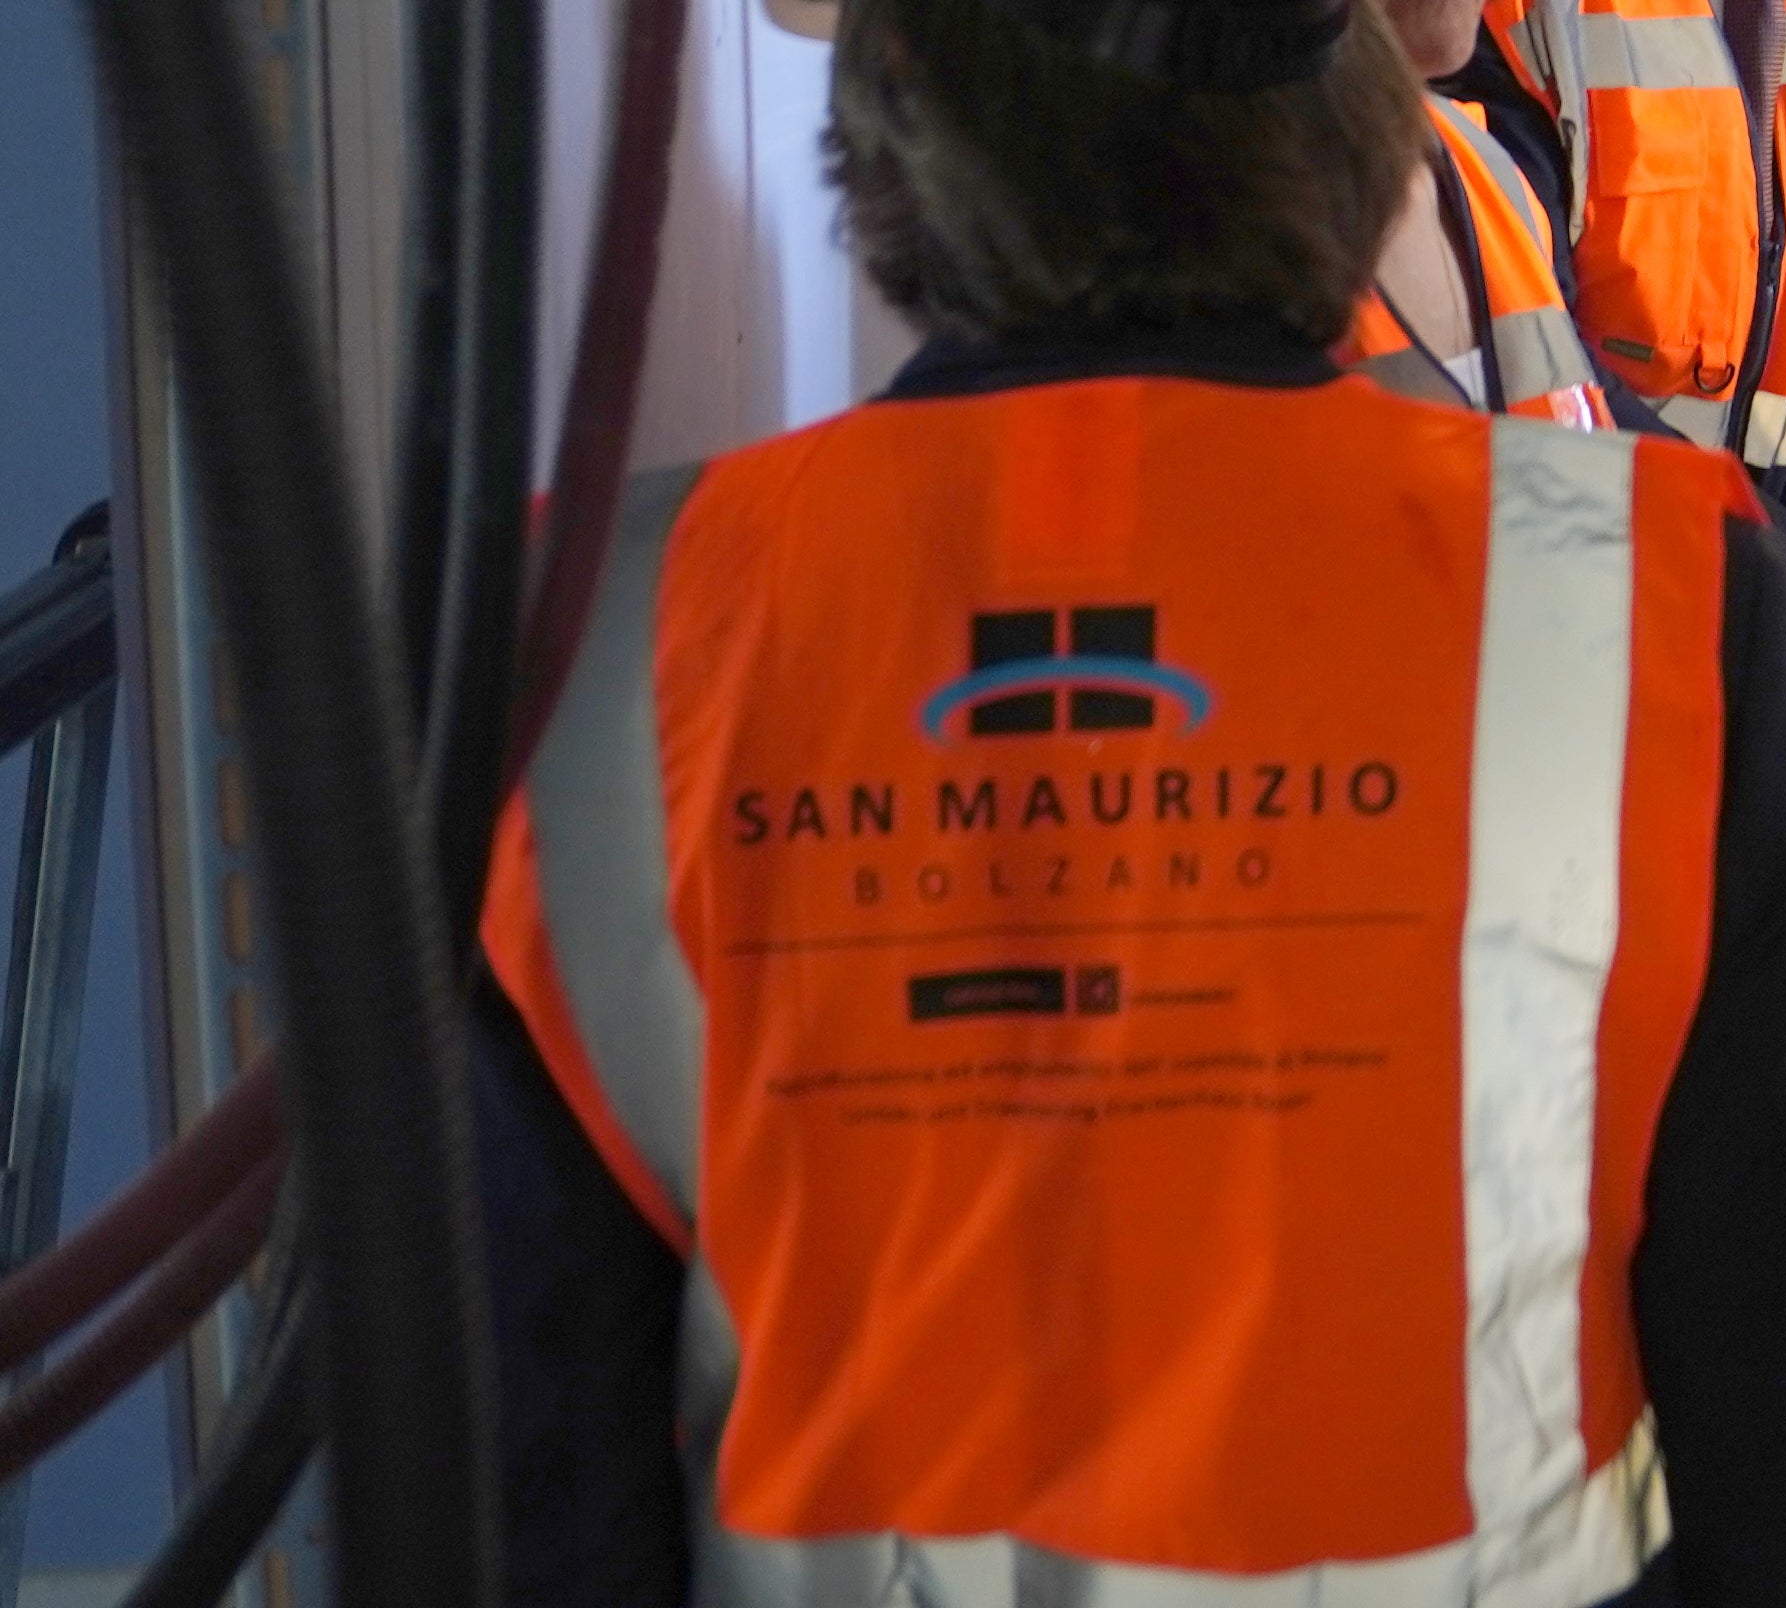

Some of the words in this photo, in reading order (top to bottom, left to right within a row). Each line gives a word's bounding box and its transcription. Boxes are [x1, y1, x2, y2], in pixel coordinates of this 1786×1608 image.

[734, 782, 895, 845] SAN
[937, 759, 1399, 833] MAURIZIO
[853, 845, 1273, 907] BOLZANO
